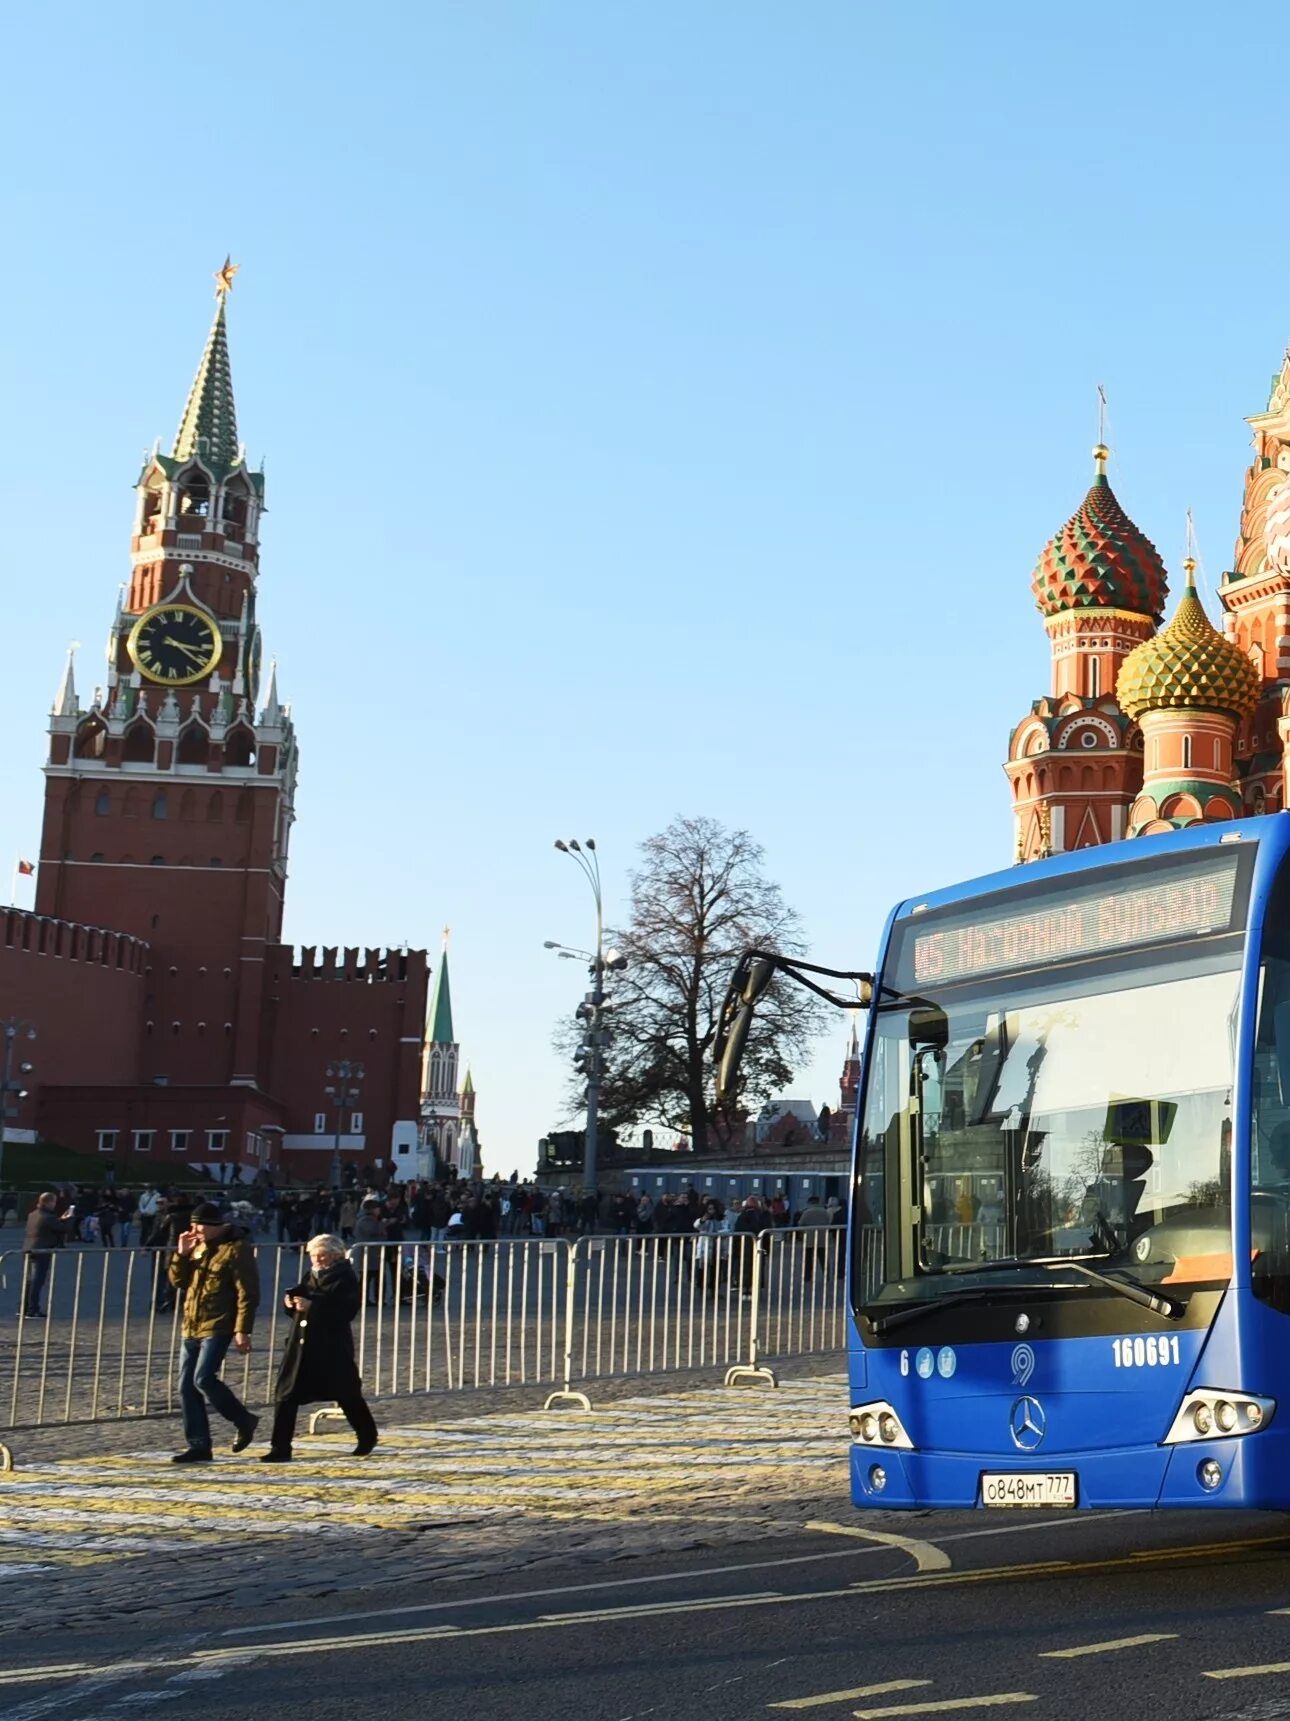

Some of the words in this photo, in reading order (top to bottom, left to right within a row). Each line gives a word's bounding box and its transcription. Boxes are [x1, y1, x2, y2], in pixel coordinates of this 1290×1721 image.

[900, 1349, 909, 1377] 6
[1112, 1335, 1180, 1368] 160691
[1047, 1476, 1070, 1493] 777
